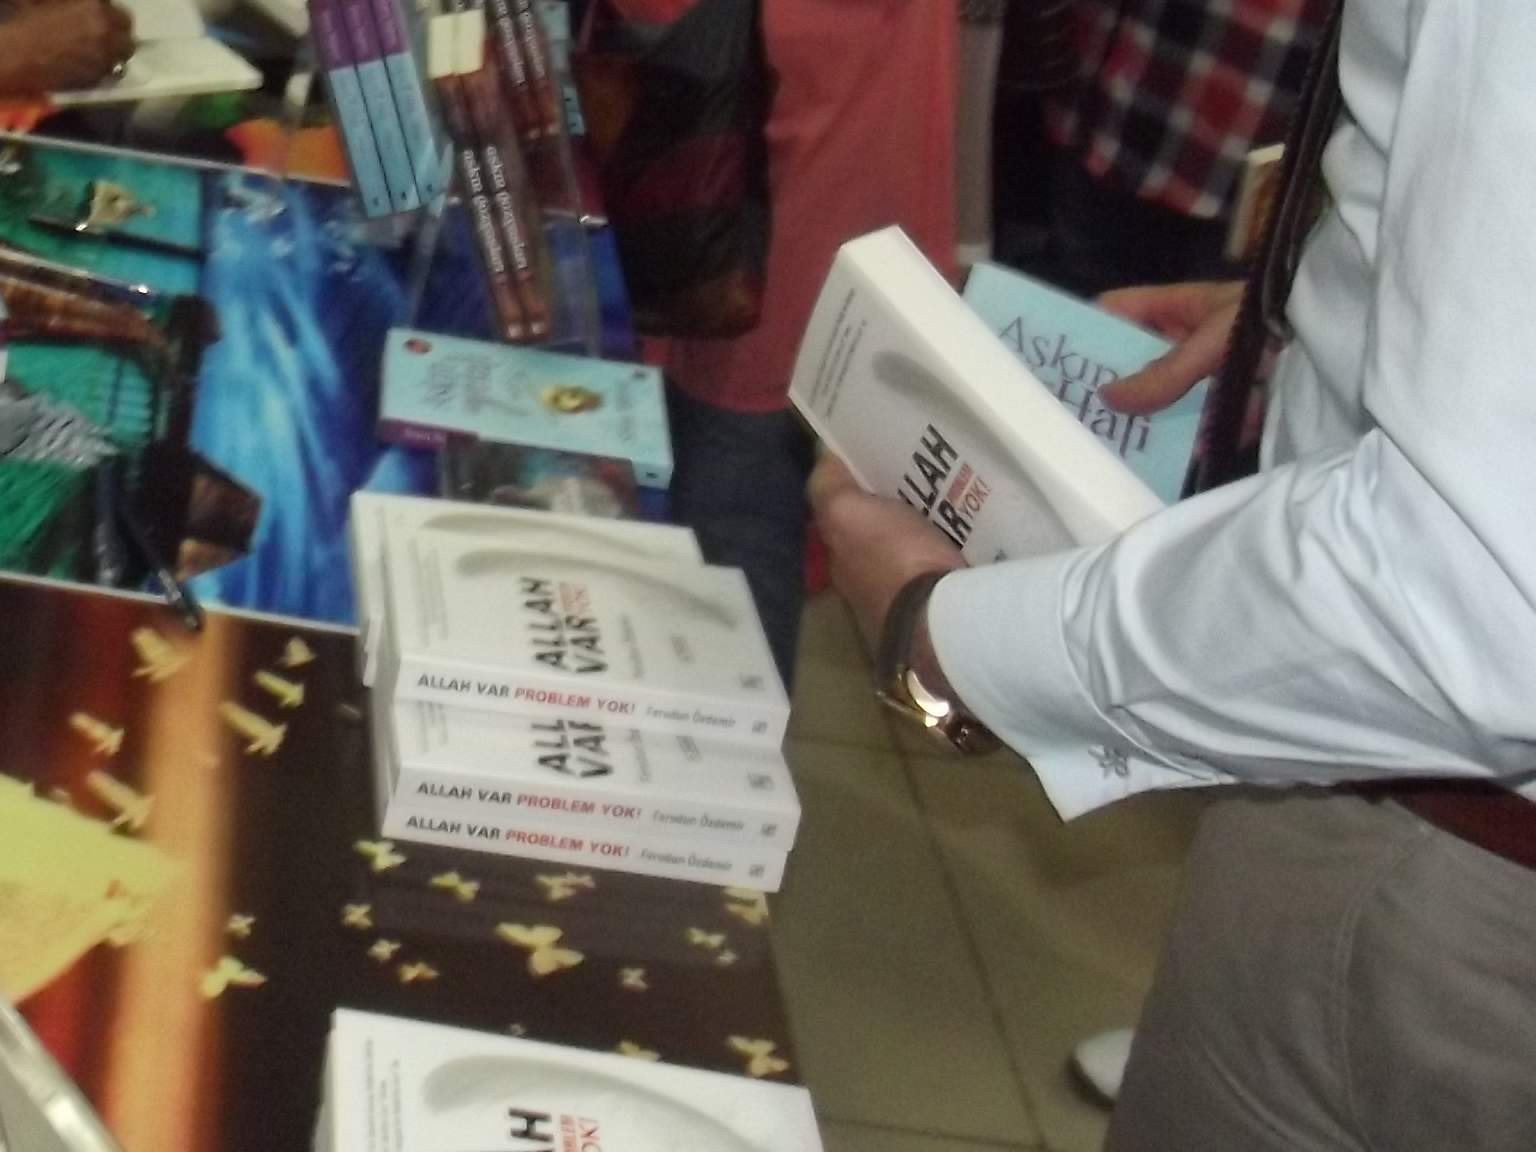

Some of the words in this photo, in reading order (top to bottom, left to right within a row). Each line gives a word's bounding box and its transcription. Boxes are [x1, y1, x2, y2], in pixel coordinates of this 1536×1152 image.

[897, 423, 958, 516] LLAH
[520, 575, 569, 671] ALLAH
[563, 614, 609, 674] VAR
[417, 673, 471, 693] ALLAH
[477, 682, 510, 698] VAR
[514, 687, 591, 708] PROBLEM
[597, 699, 635, 715] YOK!
[531, 719, 576, 776] ALL
[417, 781, 473, 799] ALLAH
[478, 790, 513, 805] VAR
[517, 793, 596, 815] PROBLEM
[602, 804, 642, 820] YOK!
[406, 815, 461, 834] ALLAH
[466, 825, 501, 840] VAR
[505, 829, 584, 851] PROBLEM
[589, 841, 630, 858] YOK!
